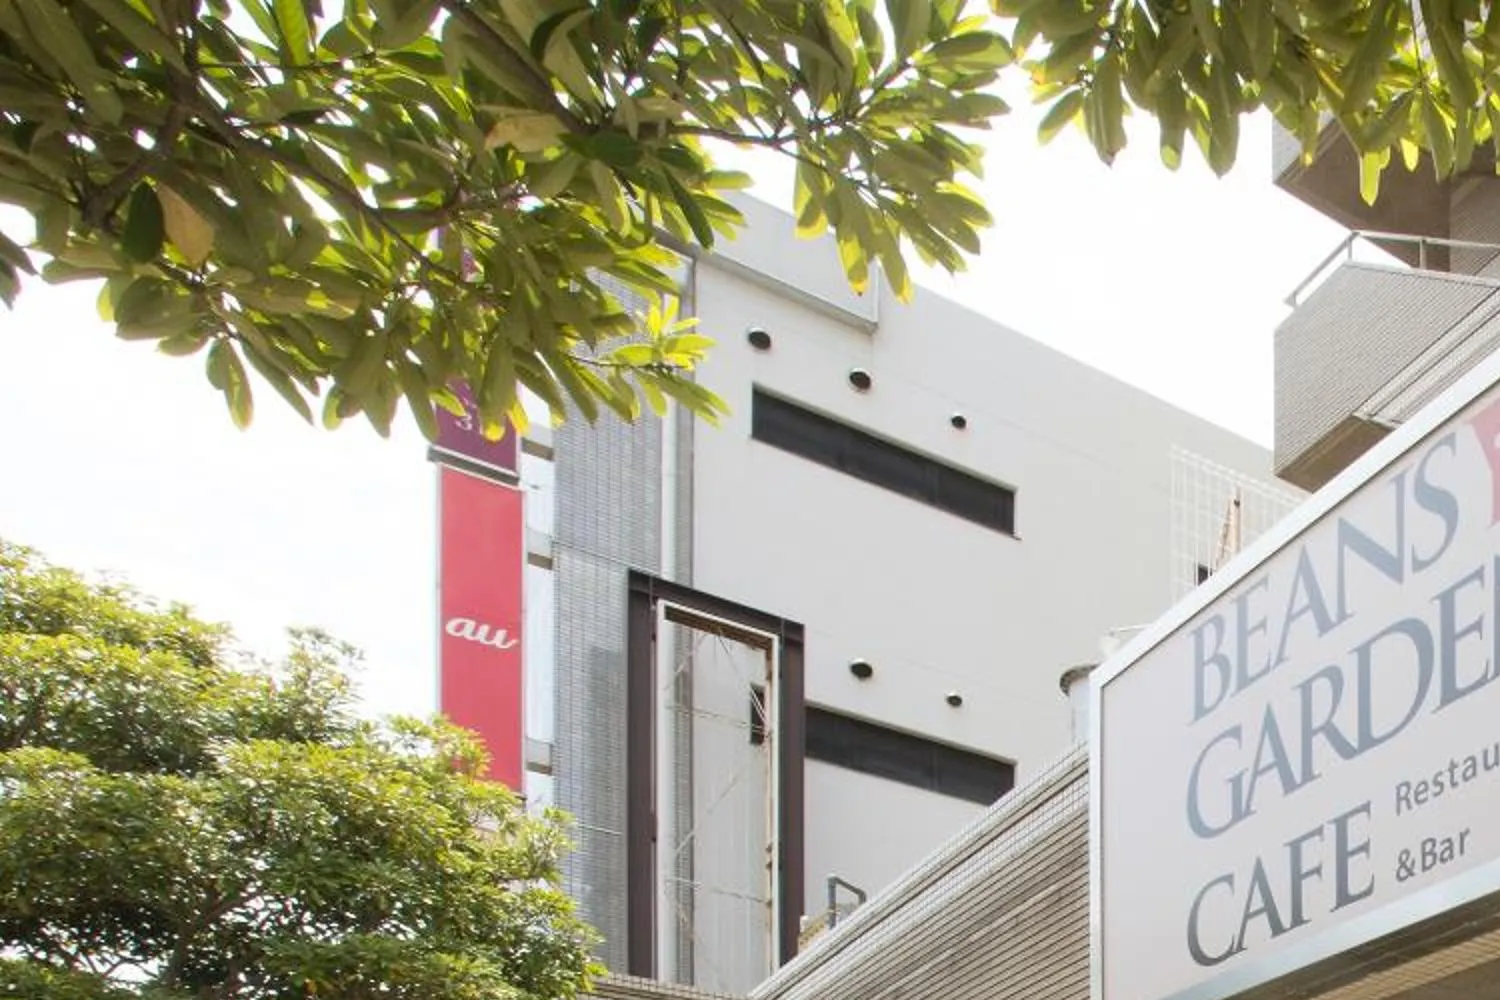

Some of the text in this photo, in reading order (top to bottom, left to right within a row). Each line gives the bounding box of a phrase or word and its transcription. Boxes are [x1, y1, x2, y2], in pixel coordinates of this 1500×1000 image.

[445, 617, 518, 649] au
[1394, 825, 1472, 883] &Bar
[1185, 801, 1377, 968] CAFE
